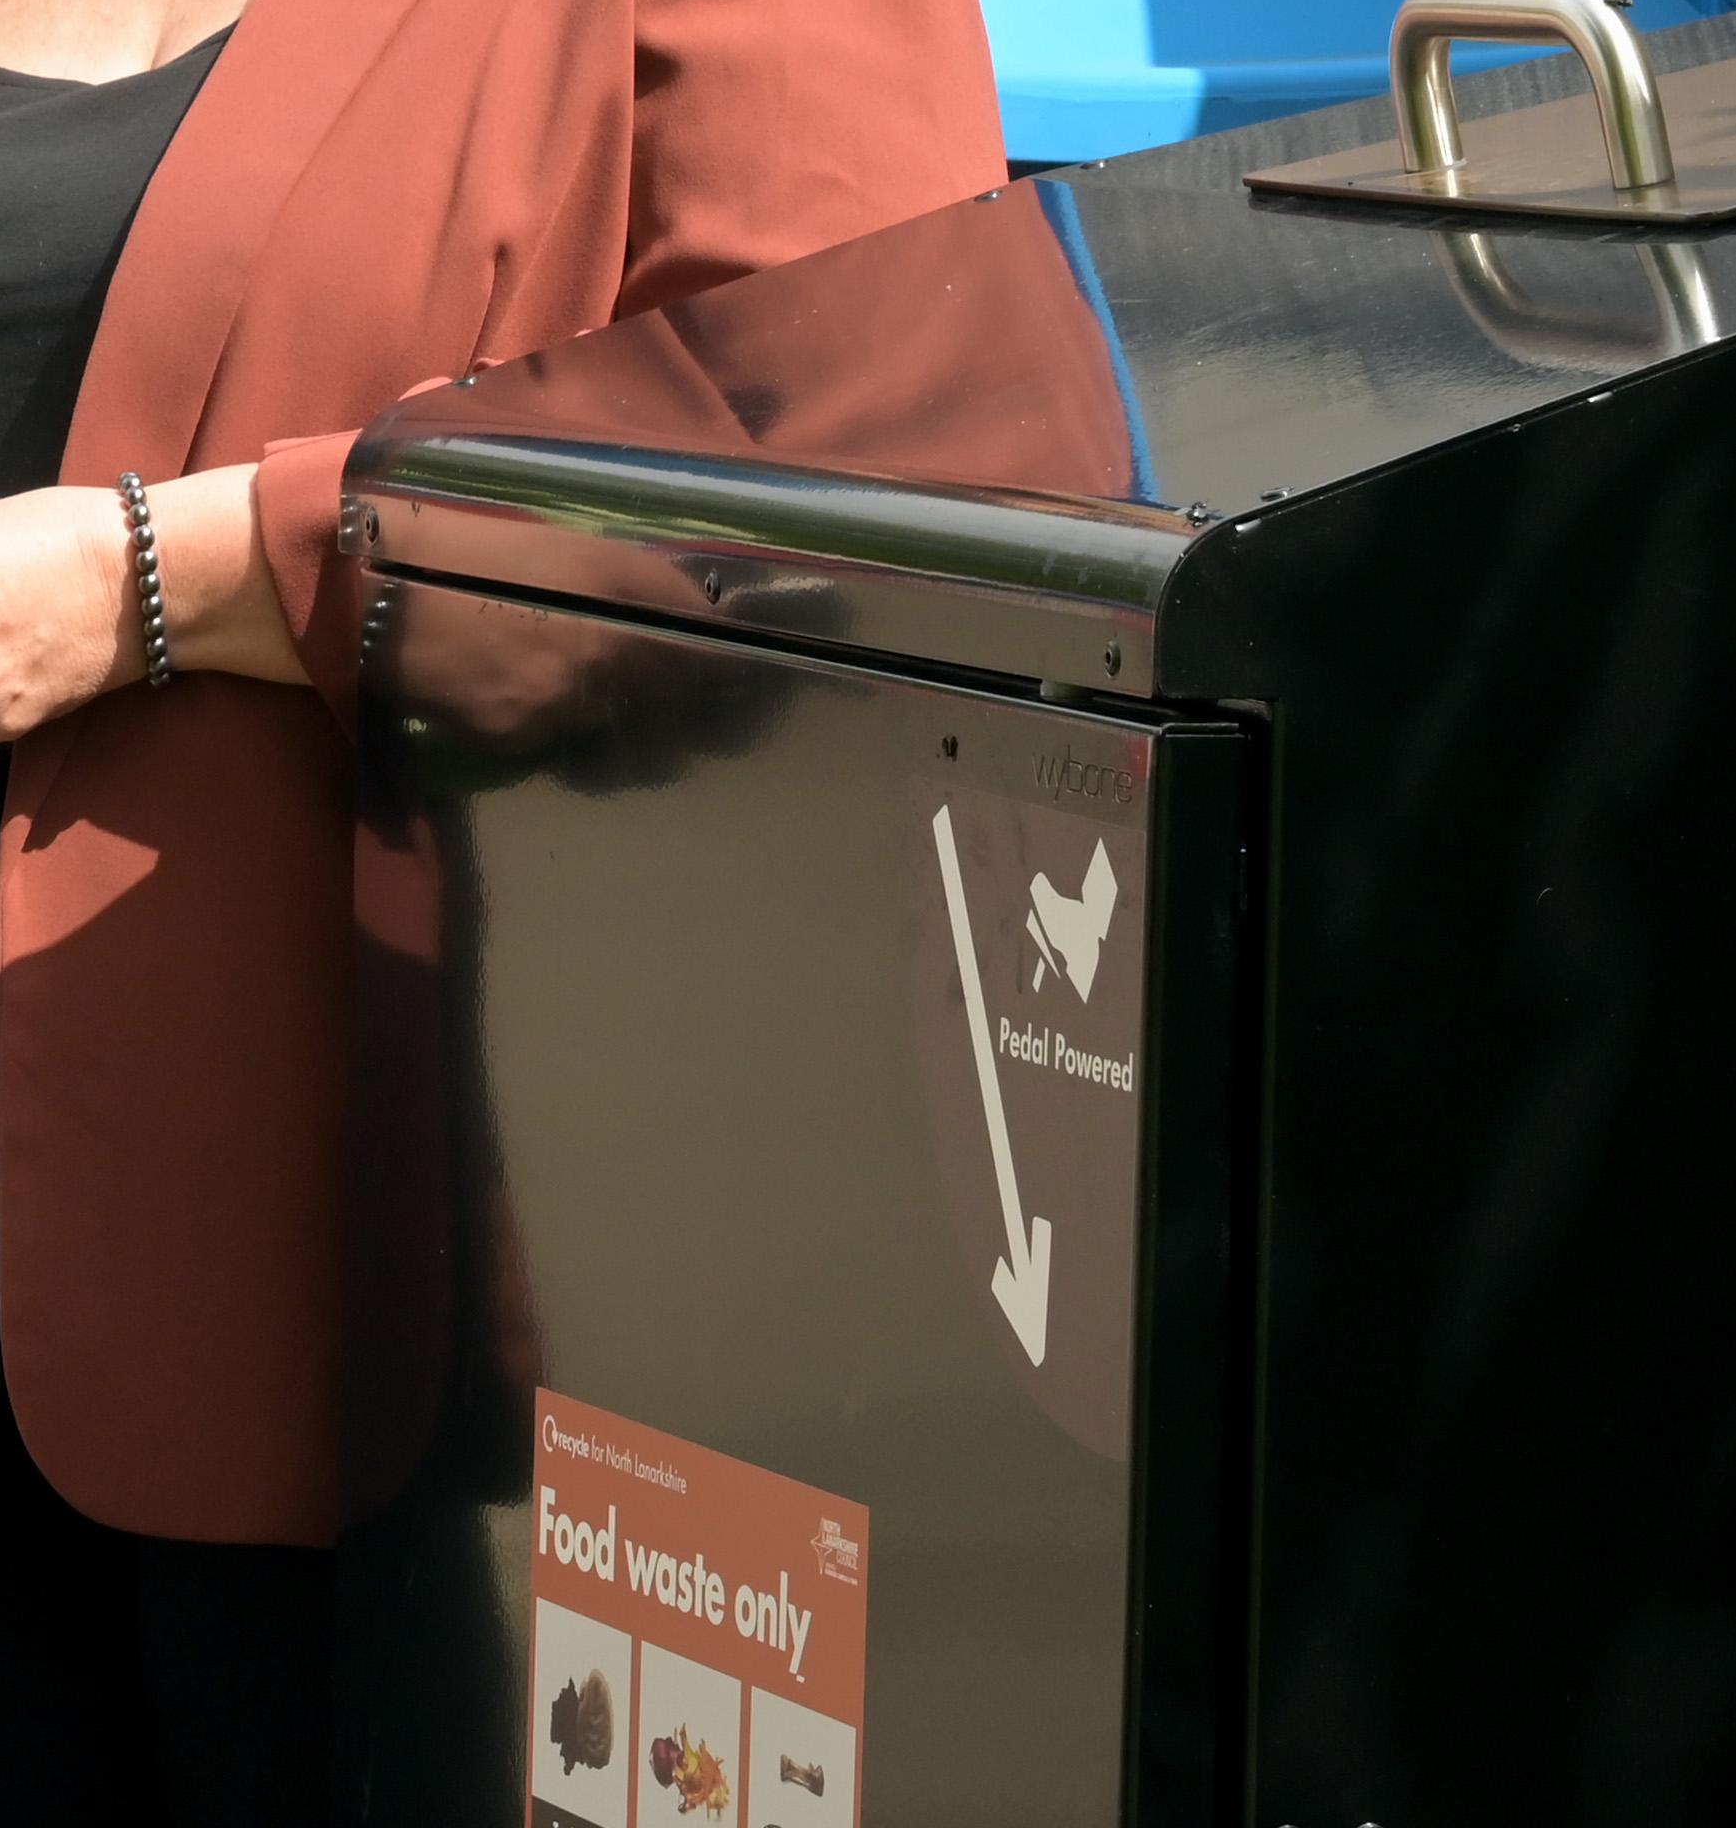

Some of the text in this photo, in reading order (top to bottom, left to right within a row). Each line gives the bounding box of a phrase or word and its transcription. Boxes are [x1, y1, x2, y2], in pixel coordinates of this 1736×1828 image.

[1032, 744, 1133, 804] wybone
[1000, 1017, 1133, 1091] Pedal Powered
[559, 1433, 686, 1494] recycle for North Lanarkshire
[539, 1485, 811, 1674] Food waste only
